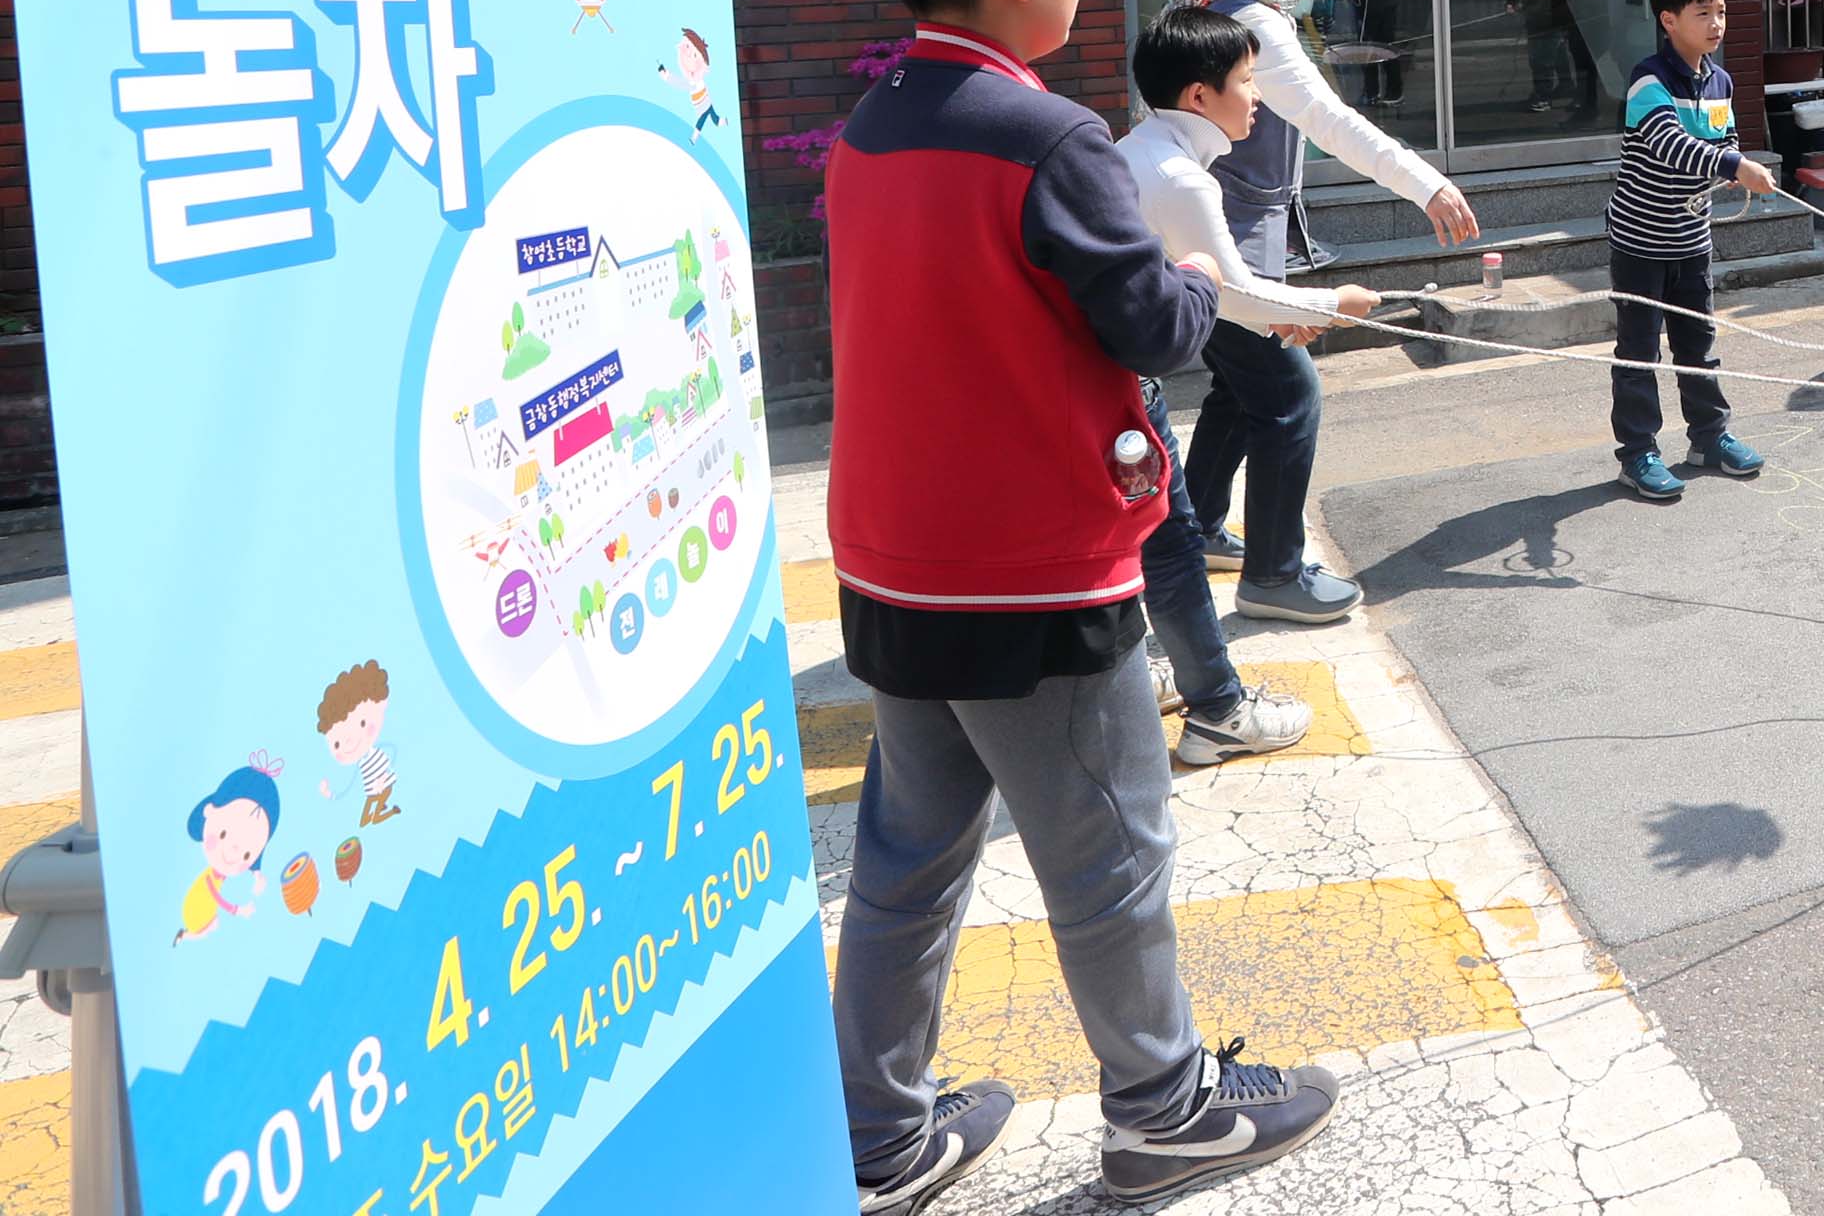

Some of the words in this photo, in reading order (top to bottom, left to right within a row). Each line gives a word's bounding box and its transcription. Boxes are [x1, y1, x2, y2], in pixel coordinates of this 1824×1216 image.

[520, 234, 589, 263] 창영초등학교
[524, 362, 621, 433] 금창동행정복지센터
[499, 581, 535, 626] 드론
[202, 1034, 409, 1216] 2018.
[424, 935, 491, 1053] 4.
[502, 844, 603, 995] 25.
[652, 758, 706, 860] 7.
[710, 697, 787, 817] 25.
[408, 1041, 537, 1216] 수요일
[550, 832, 774, 1074] 14:00~16:00
